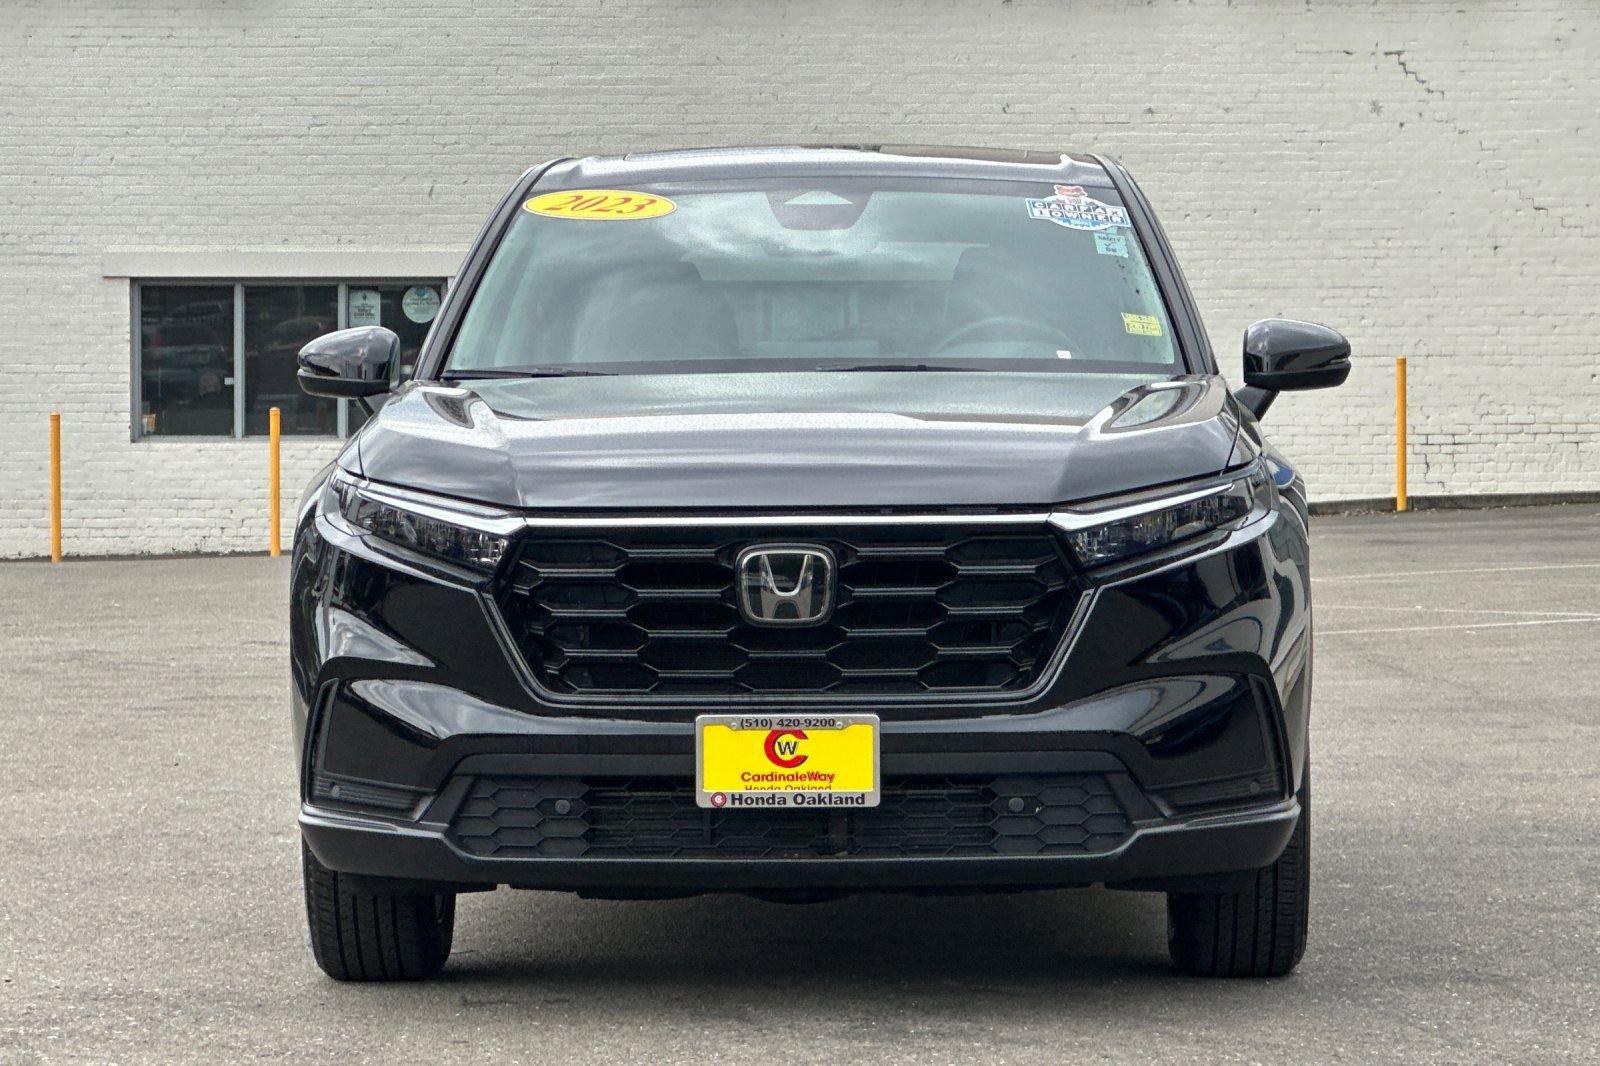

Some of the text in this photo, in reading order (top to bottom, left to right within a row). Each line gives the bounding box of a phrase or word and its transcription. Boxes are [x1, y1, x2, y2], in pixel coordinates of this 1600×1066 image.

[541, 194, 657, 214] 2023
[1033, 202, 1121, 217] CARFAX
[1051, 210, 1123, 224] OWNER
[740, 718, 836, 729] (510) 420-9200
[740, 771, 836, 784] CardinaleWay
[730, 793, 786, 806] Honda
[792, 793, 866, 806] Oakland
